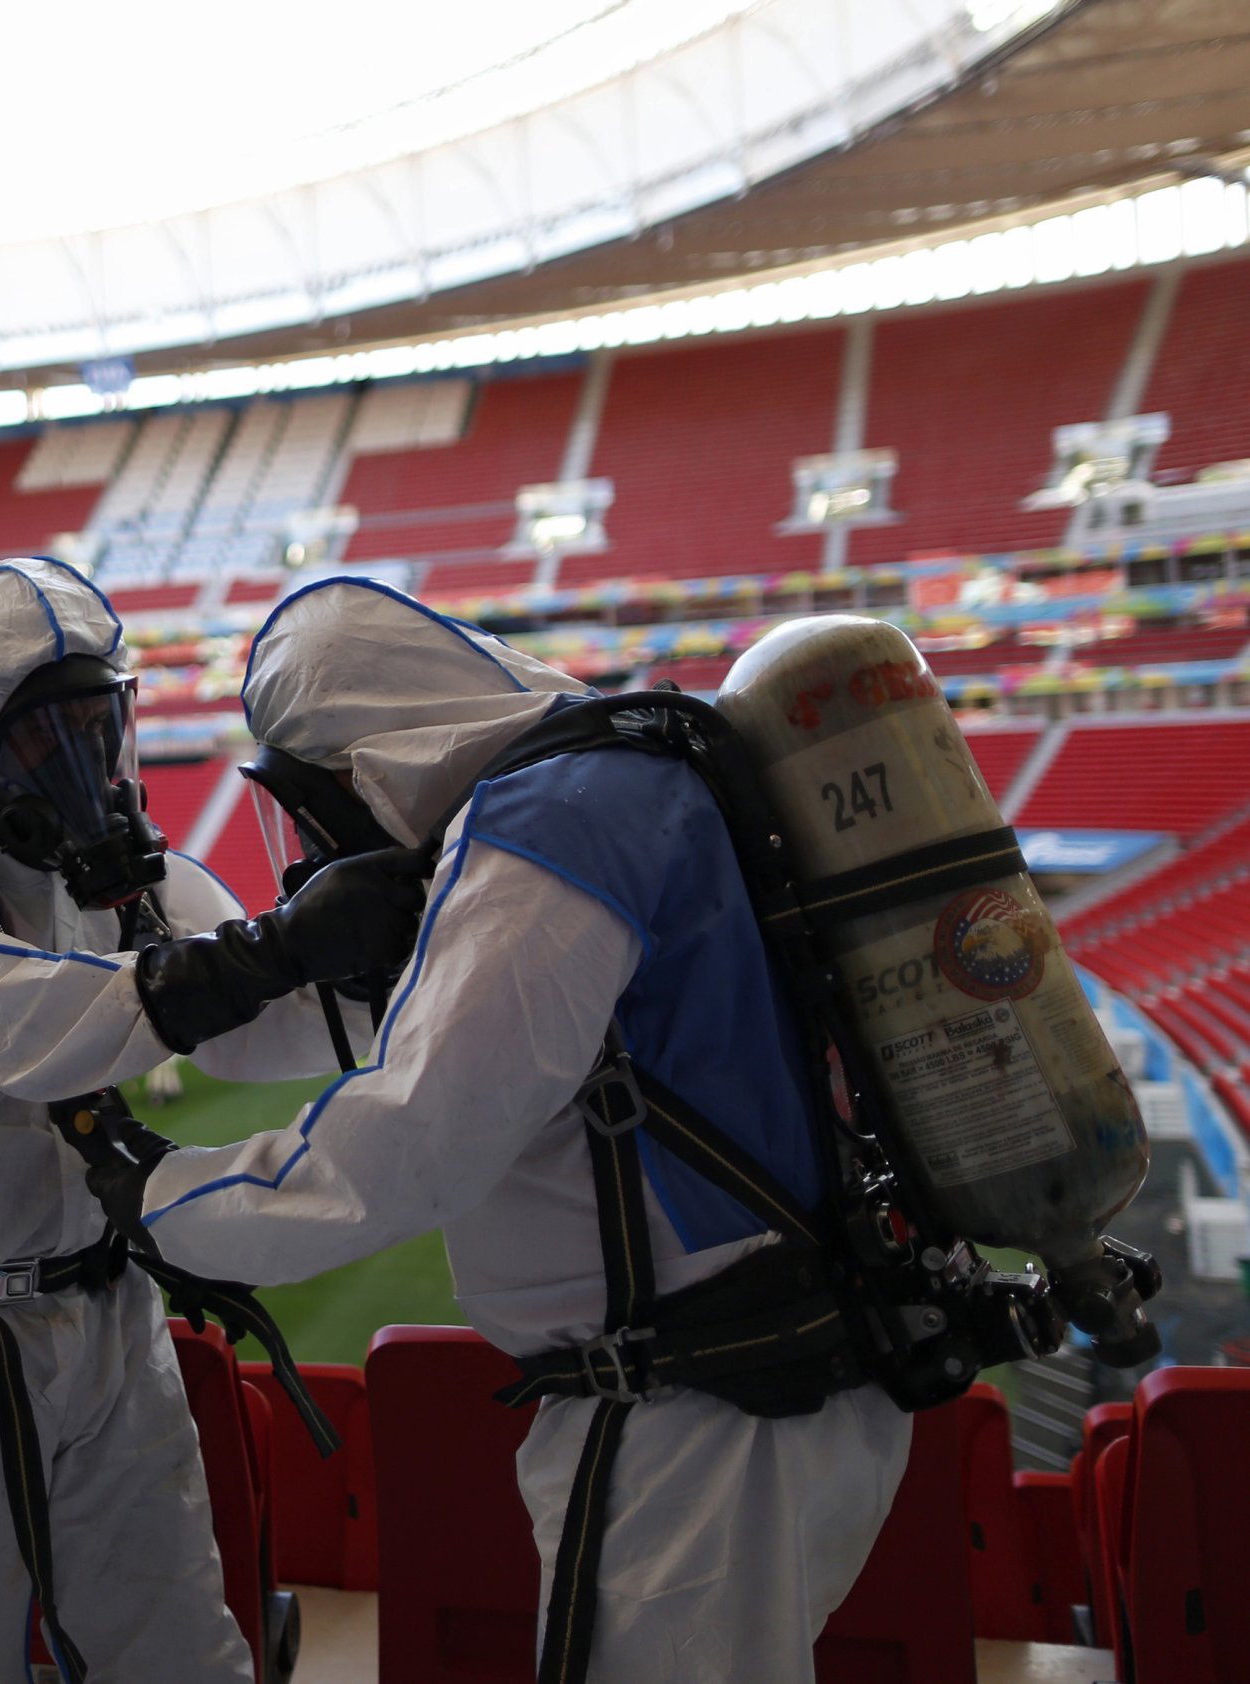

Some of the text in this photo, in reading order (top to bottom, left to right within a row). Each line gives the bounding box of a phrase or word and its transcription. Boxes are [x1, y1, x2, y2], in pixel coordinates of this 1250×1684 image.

[821, 762, 894, 833] 247
[856, 952, 941, 1004] SCOT
[861, 983, 943, 1020] SAFET
[895, 1030, 935, 1053] SCOTT
[945, 1051, 966, 1065] LBS
